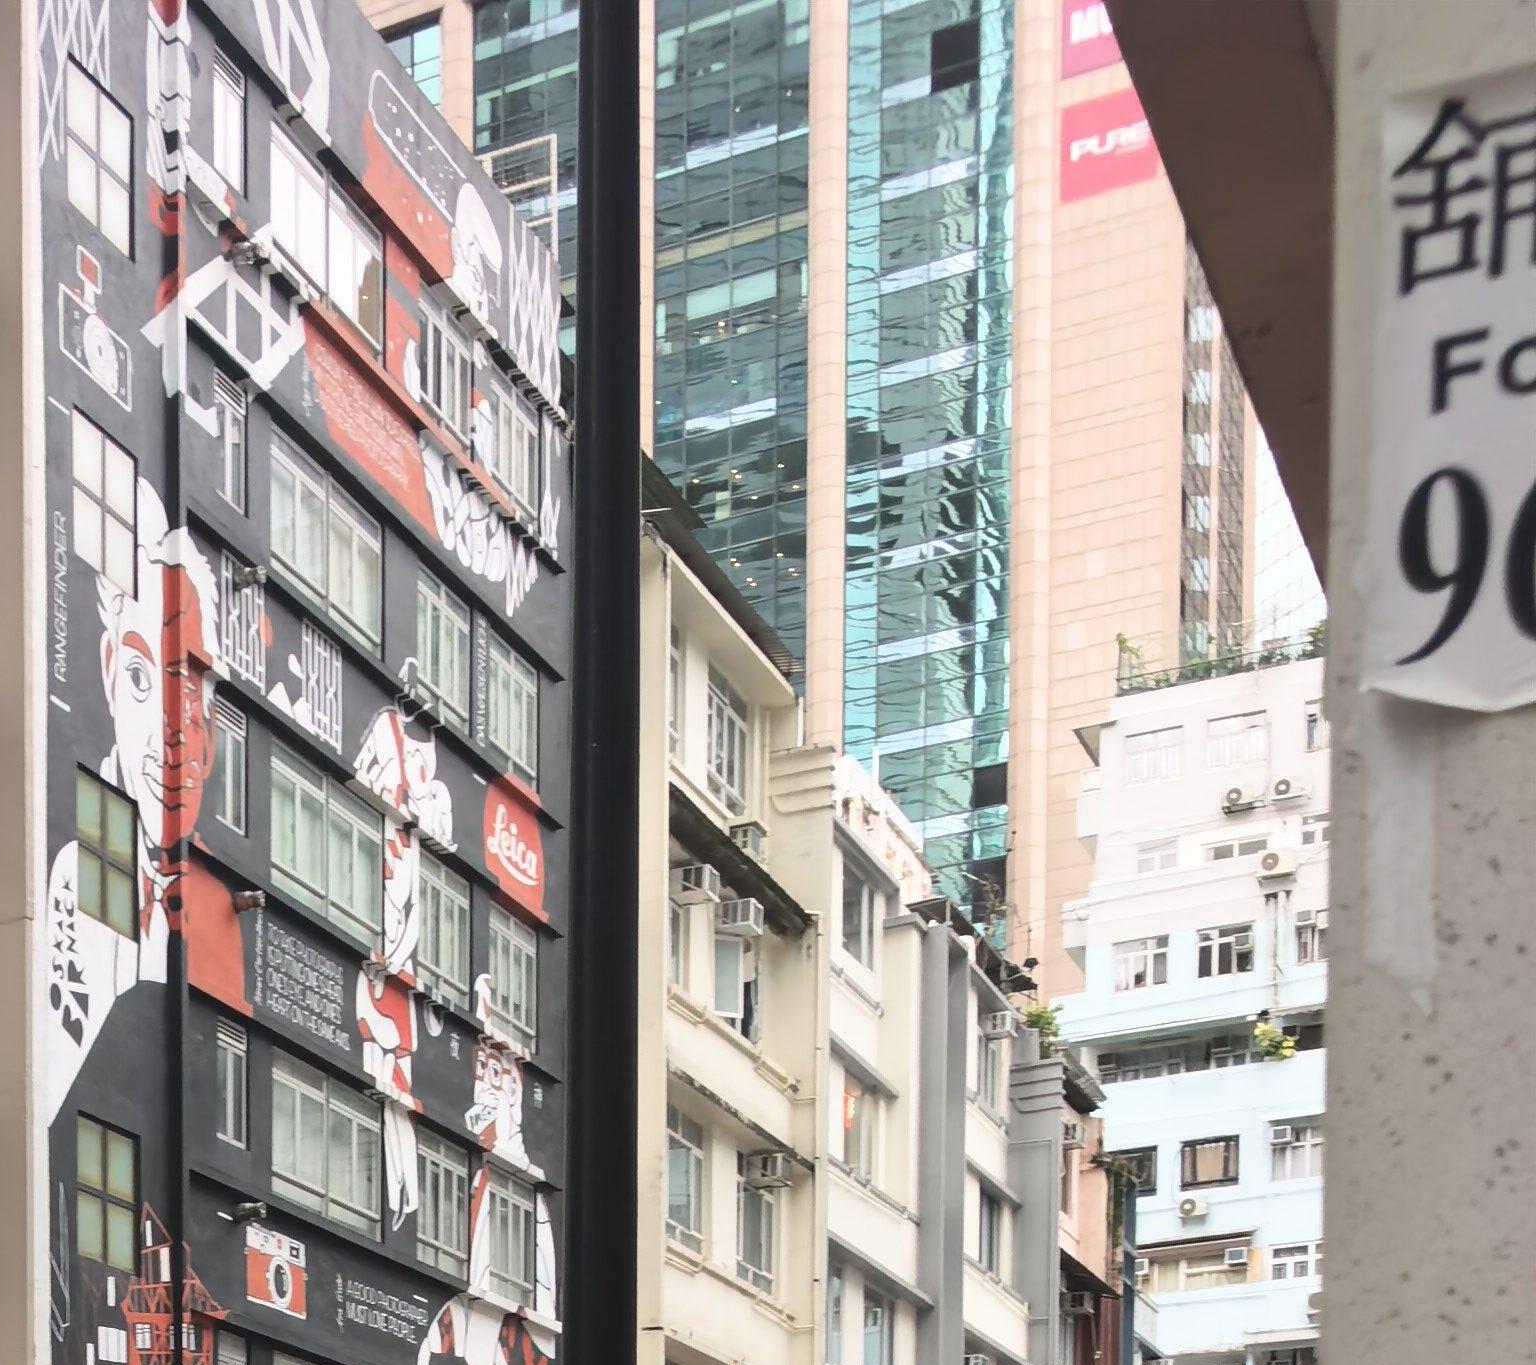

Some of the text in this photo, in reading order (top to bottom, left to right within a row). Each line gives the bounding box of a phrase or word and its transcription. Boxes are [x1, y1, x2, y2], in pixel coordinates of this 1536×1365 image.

[1069, 119, 1150, 162] PURE
[53, 509, 68, 683] RANGEFINDER
[487, 803, 539, 885] Leica
